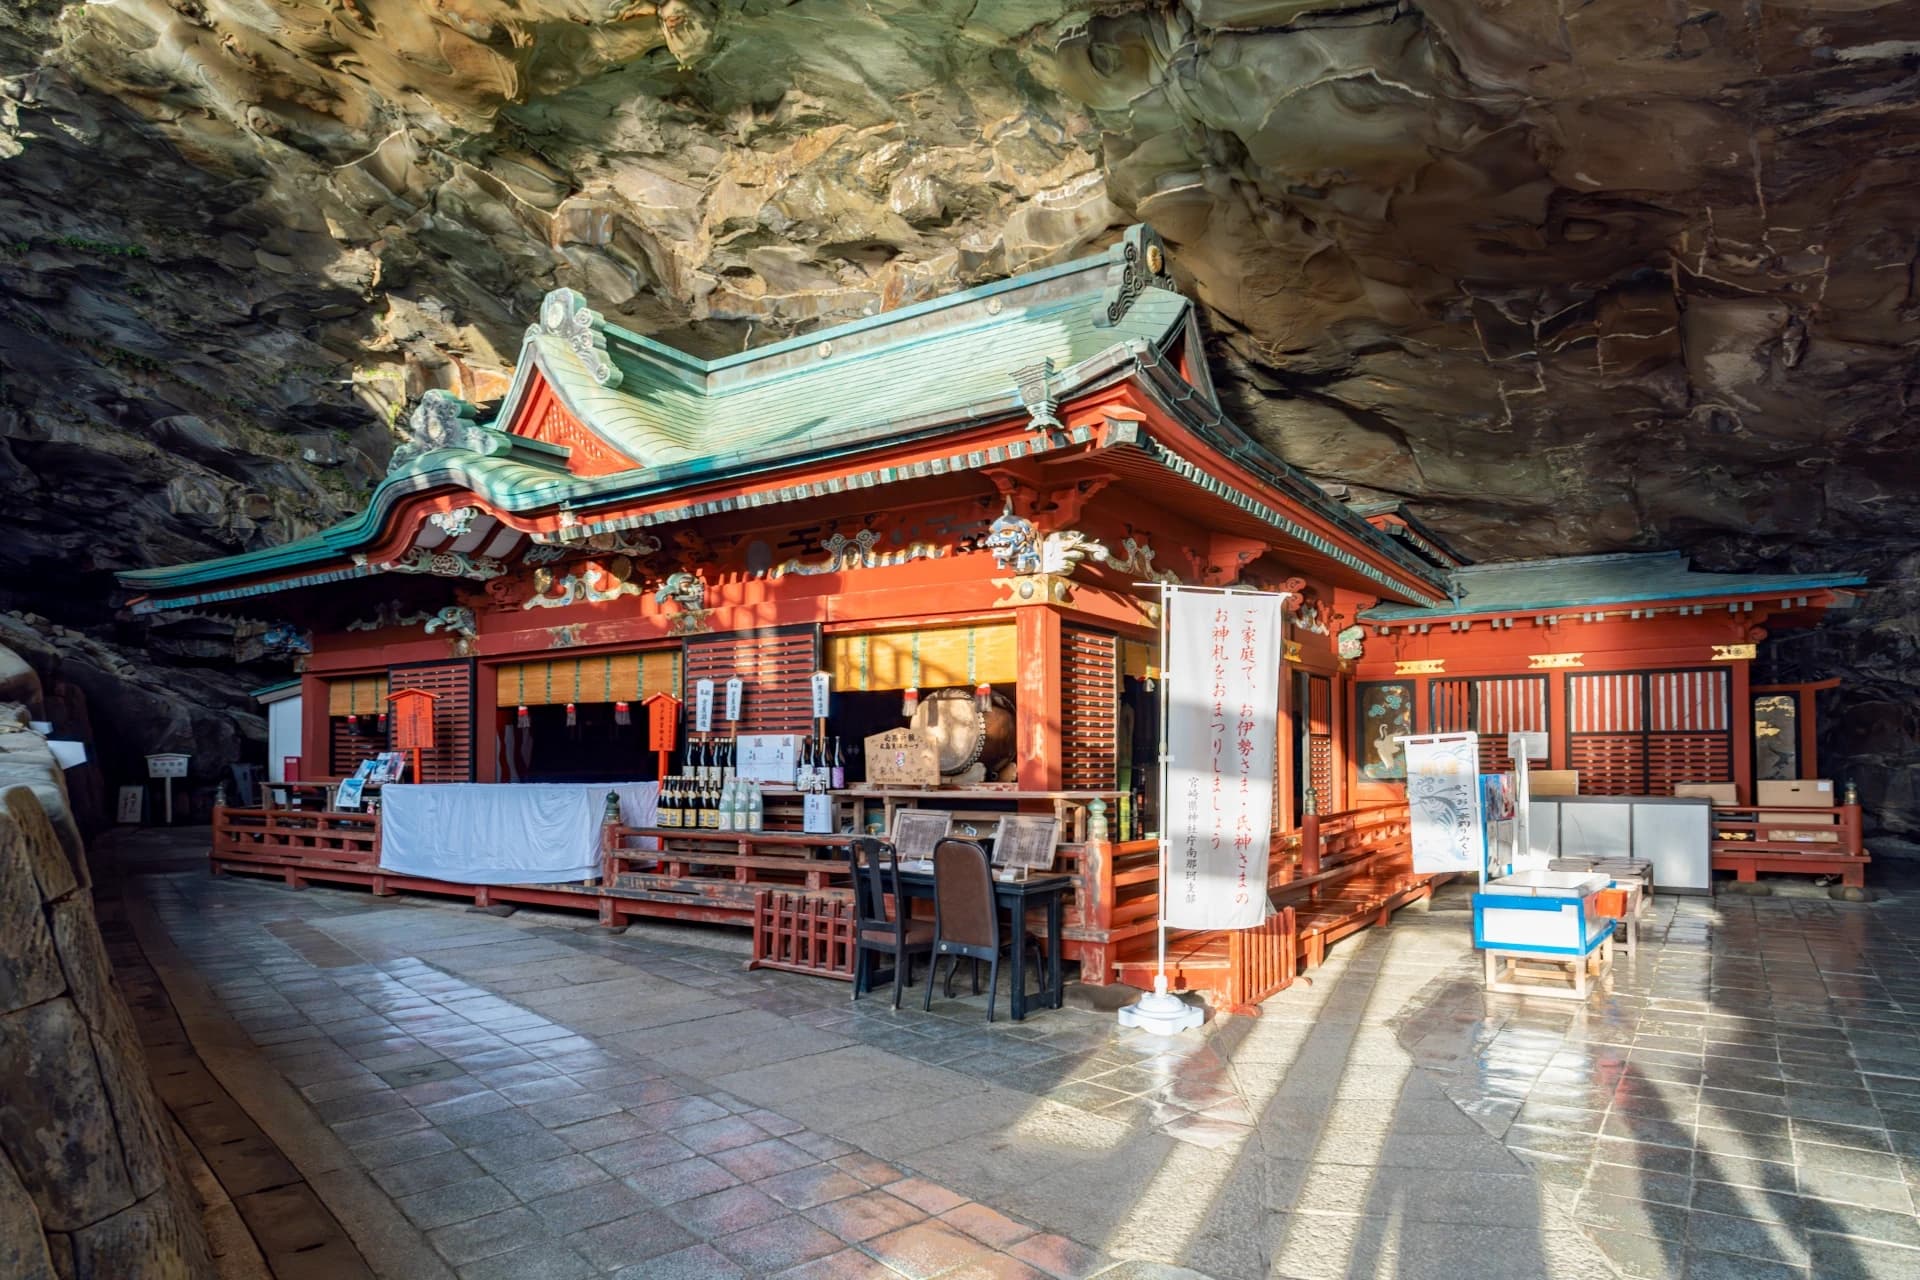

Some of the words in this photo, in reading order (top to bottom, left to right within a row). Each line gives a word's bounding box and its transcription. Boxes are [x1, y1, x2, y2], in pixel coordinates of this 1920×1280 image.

[1211, 607, 1229, 850] お神札をおまつりしましょう
[1234, 608, 1257, 905] ご家庭で、お伊勢さま・氏神さまの
